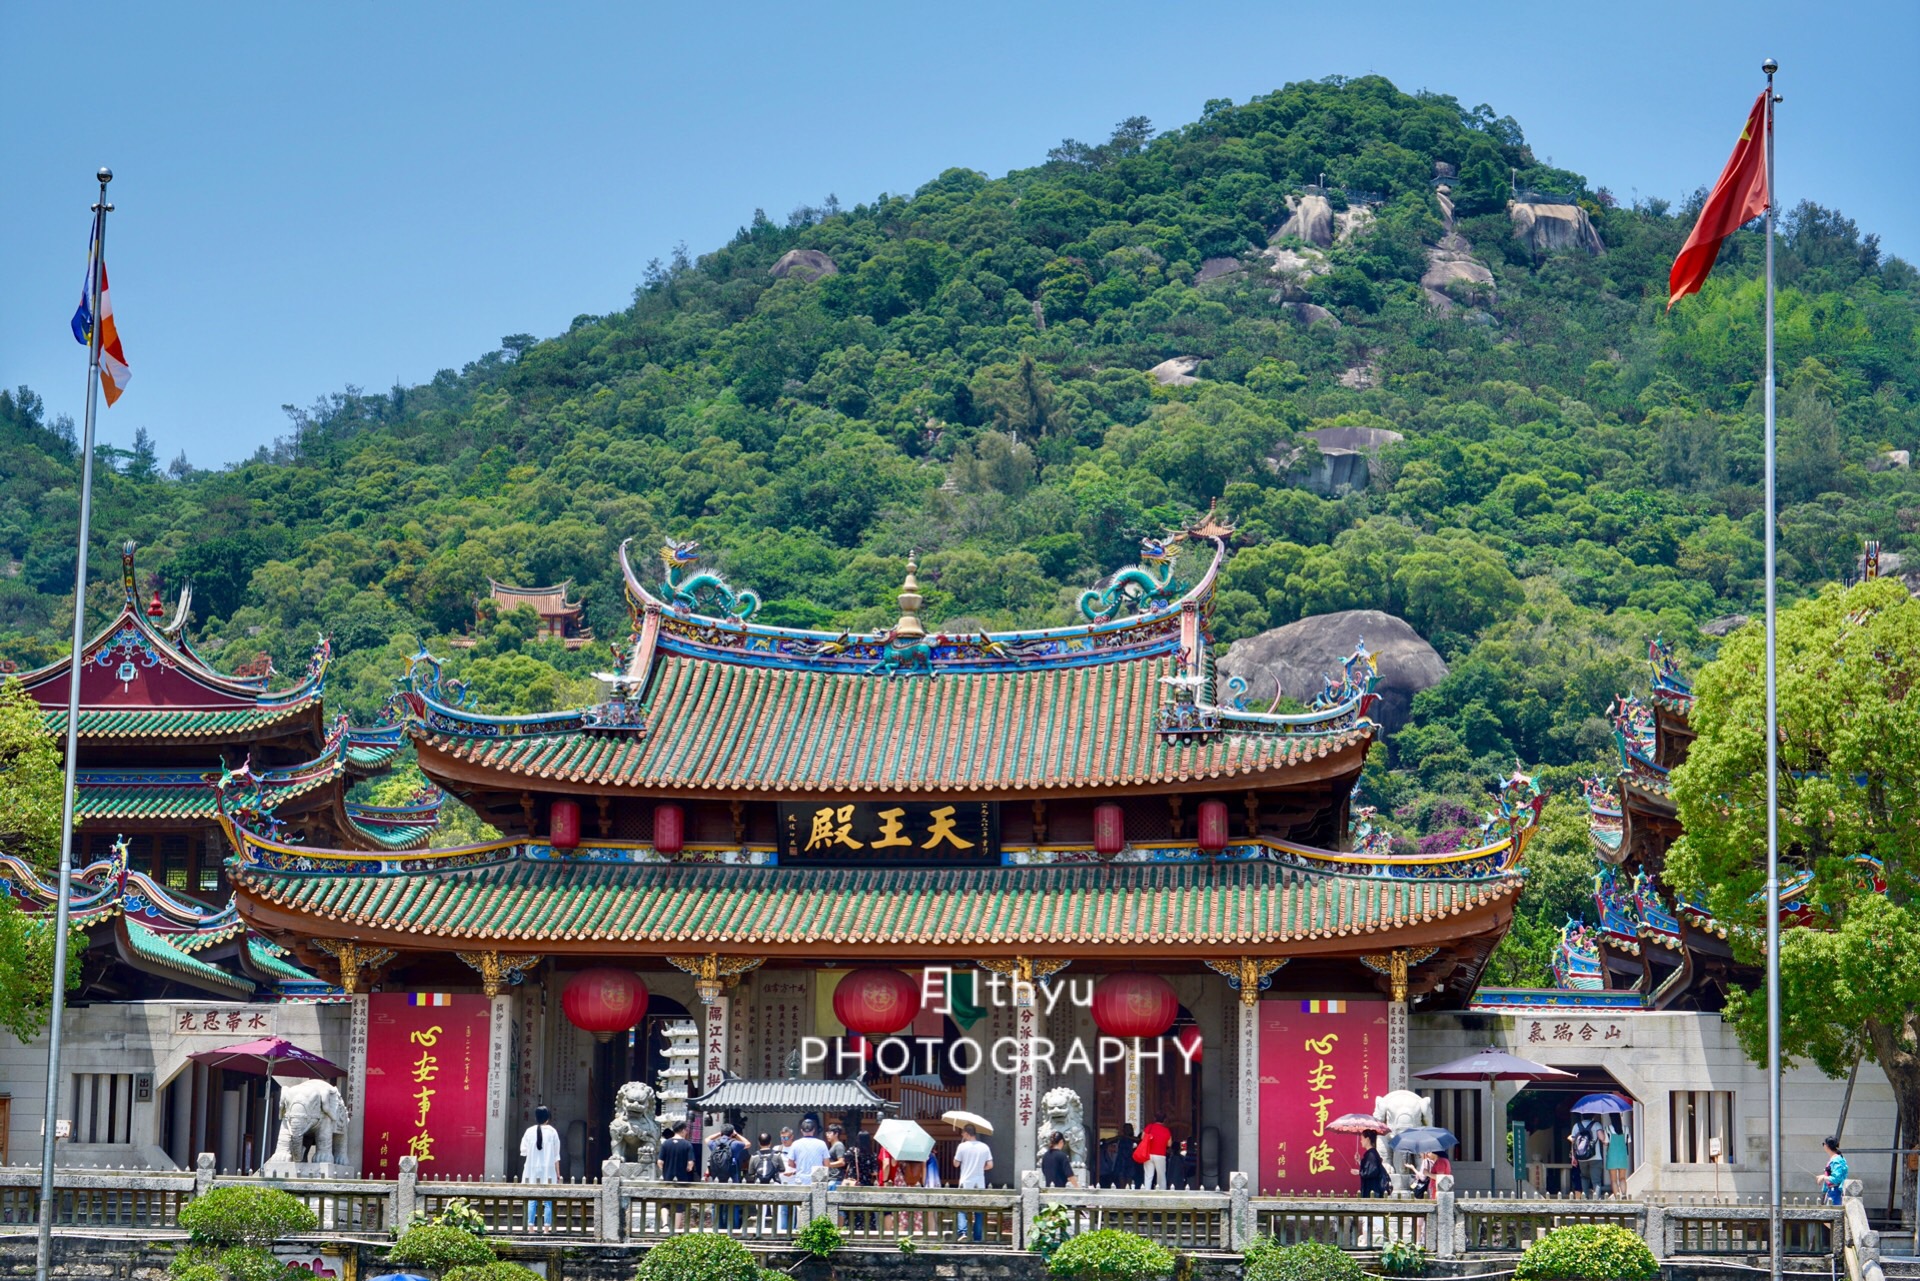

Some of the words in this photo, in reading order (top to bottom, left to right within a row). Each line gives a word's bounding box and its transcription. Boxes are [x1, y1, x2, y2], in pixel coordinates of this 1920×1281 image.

[804, 804, 976, 852] 天王殿
[139, 1077, 150, 1098] 出口
[407, 1025, 443, 1162] 心安事隆
[1304, 1032, 1339, 1176] 心安事隆
